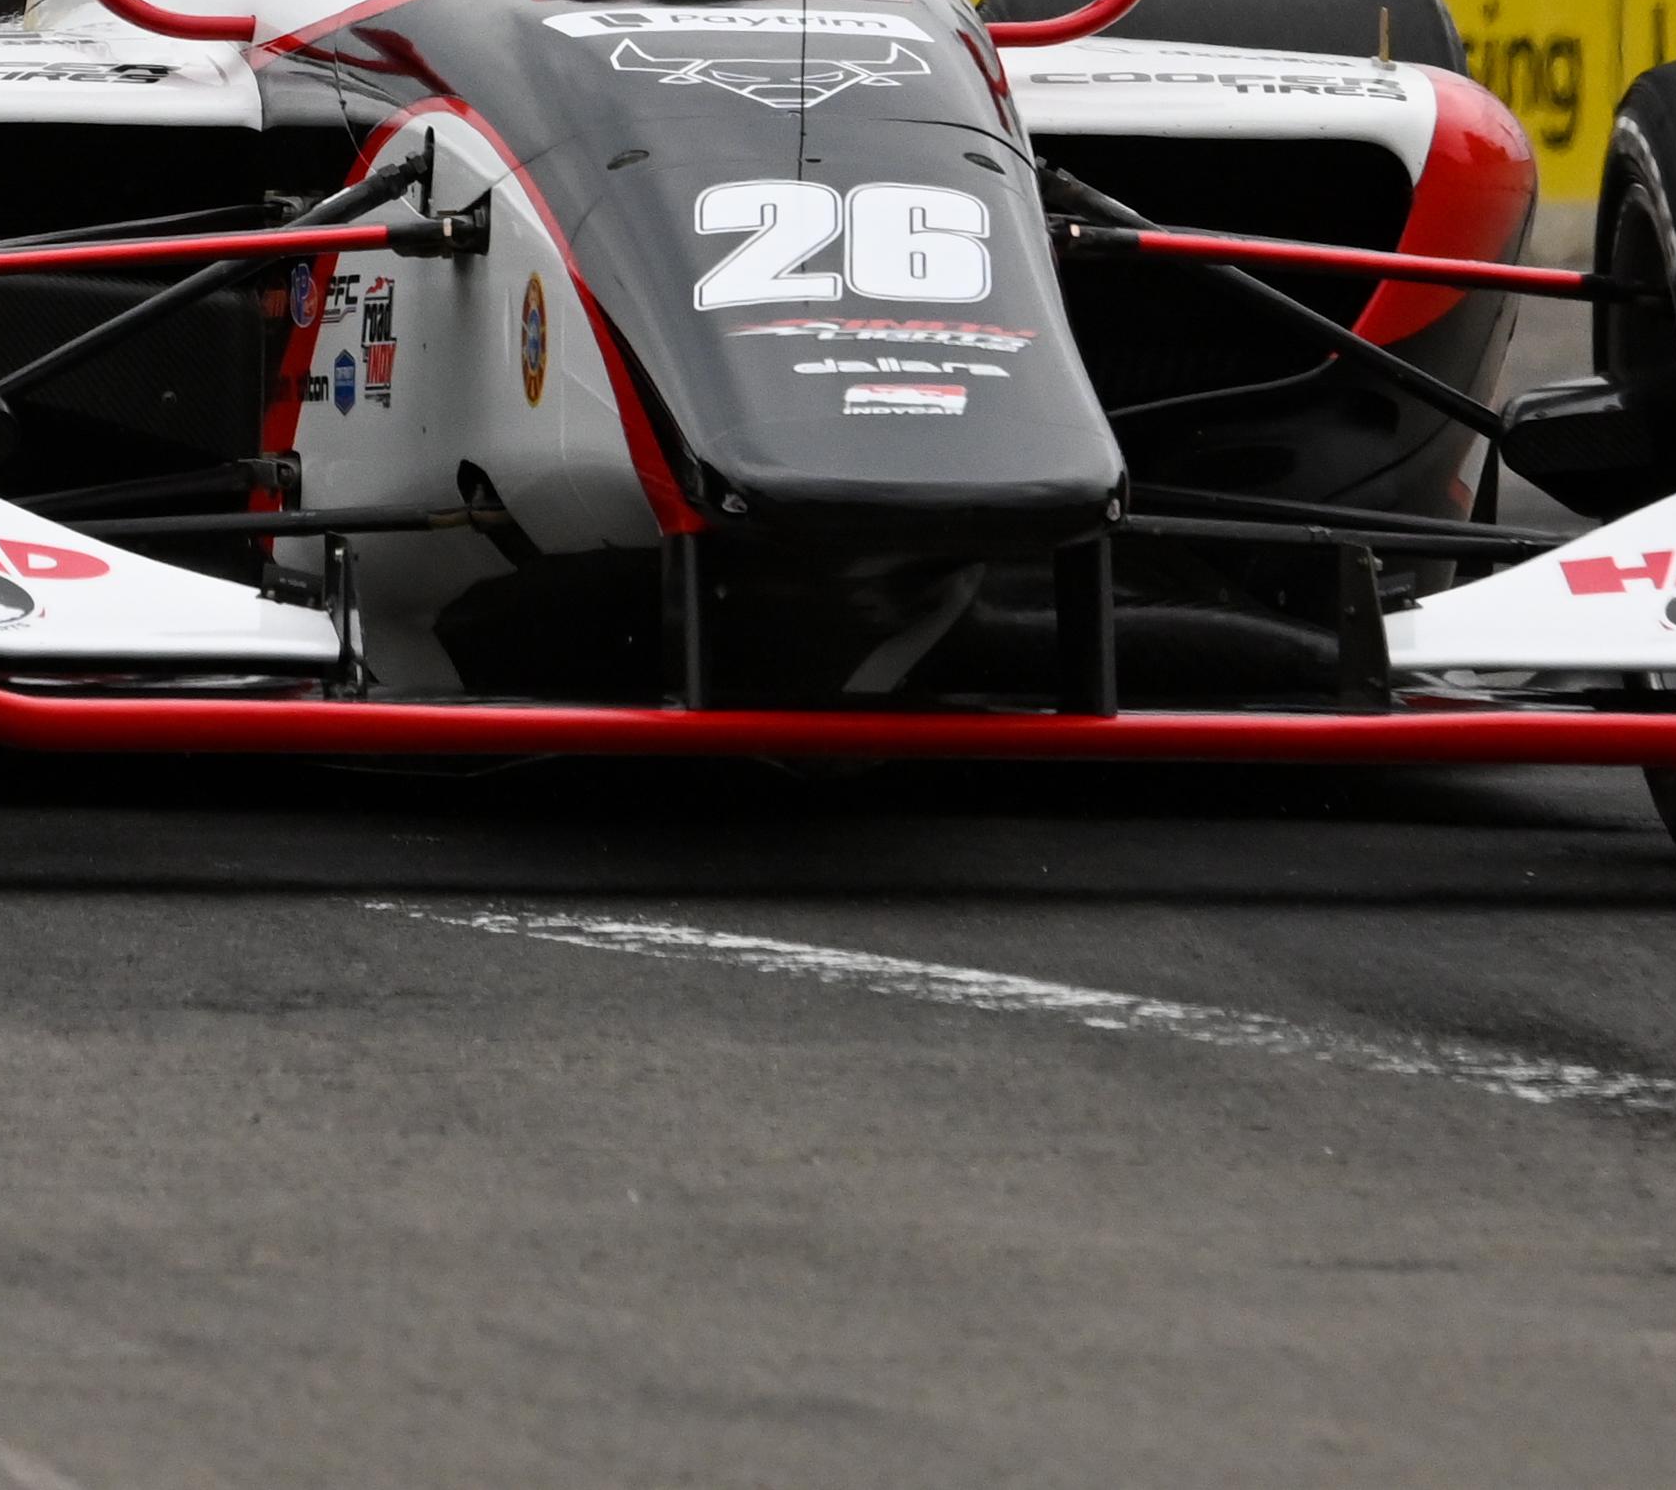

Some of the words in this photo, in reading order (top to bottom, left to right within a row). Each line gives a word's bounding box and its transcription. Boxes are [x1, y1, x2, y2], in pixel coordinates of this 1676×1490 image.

[668, 12, 888, 30] Paytrim
[1029, 72, 1404, 93] COOPER
[694, 179, 992, 311] 26
[793, 356, 1011, 378] dallara
